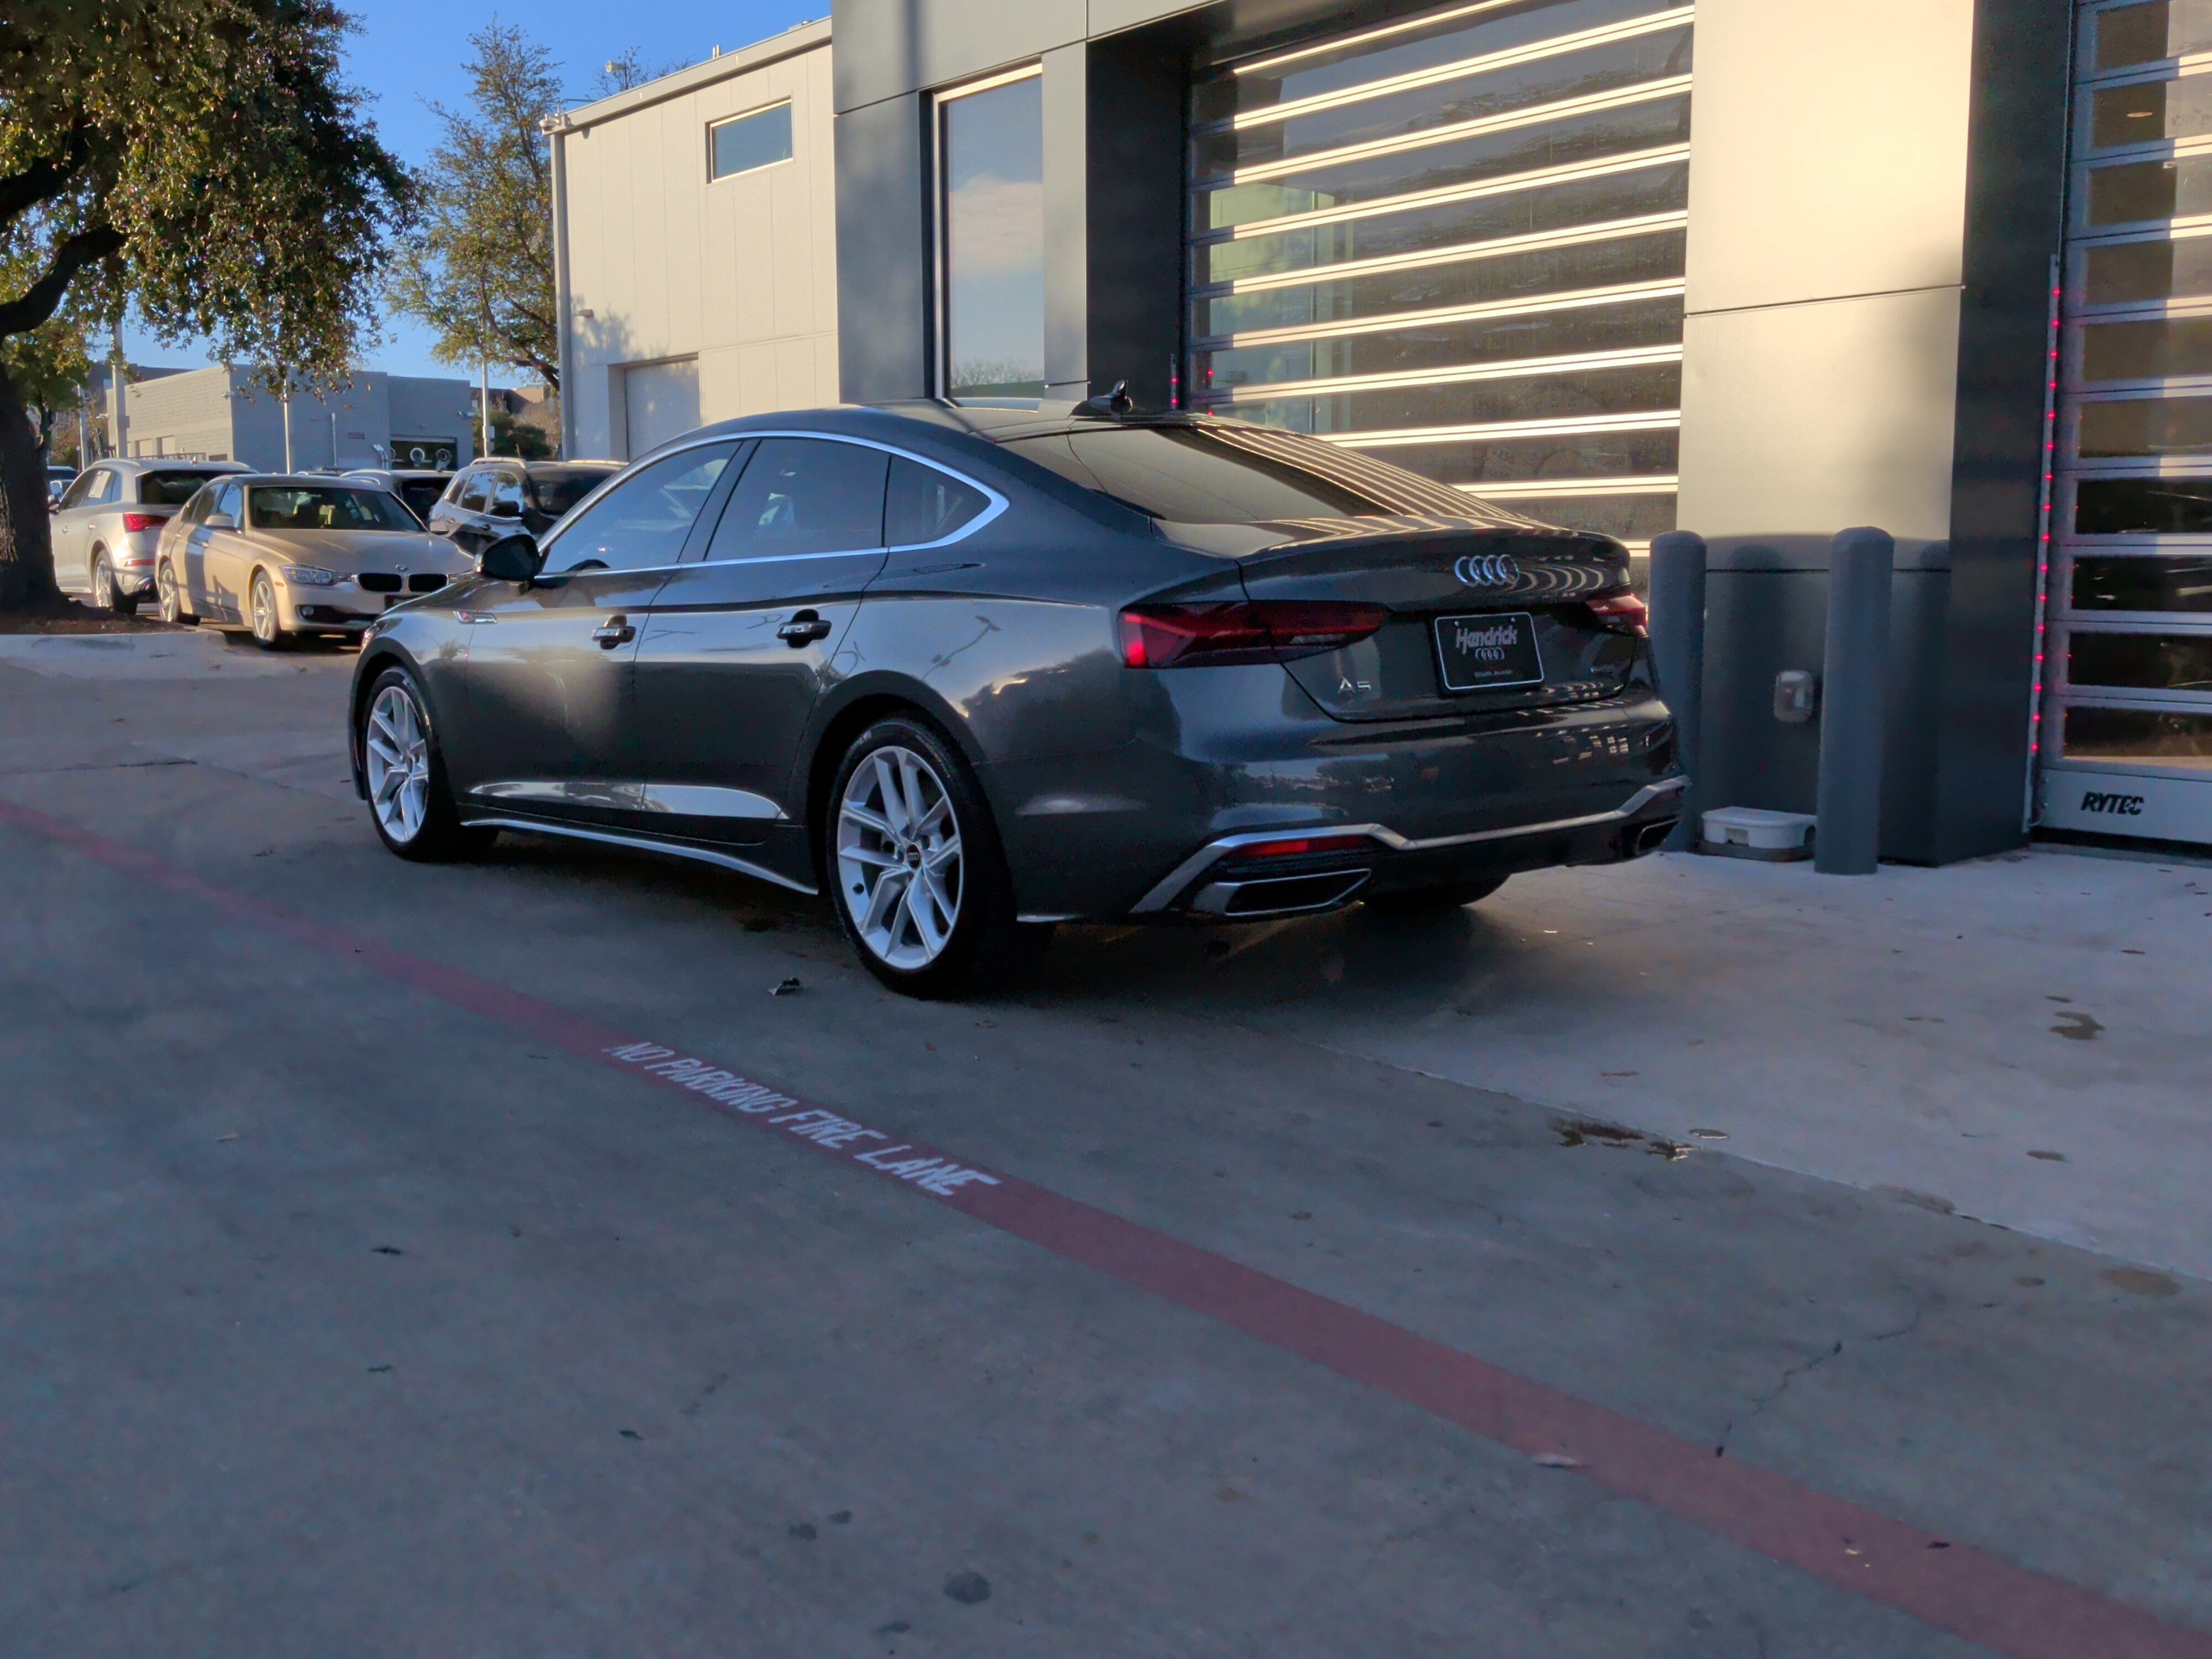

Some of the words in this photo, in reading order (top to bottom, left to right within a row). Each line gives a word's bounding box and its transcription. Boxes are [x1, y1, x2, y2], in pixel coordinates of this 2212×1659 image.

[1455, 625, 1518, 655] Hendrick
[1338, 676, 1371, 693] A5
[2081, 791, 2144, 815] RYTEC
[602, 1042, 675, 1061] NO
[644, 1058, 797, 1112] PARKING
[769, 1109, 887, 1149] FIRE
[854, 1145, 1001, 1196] LANE
